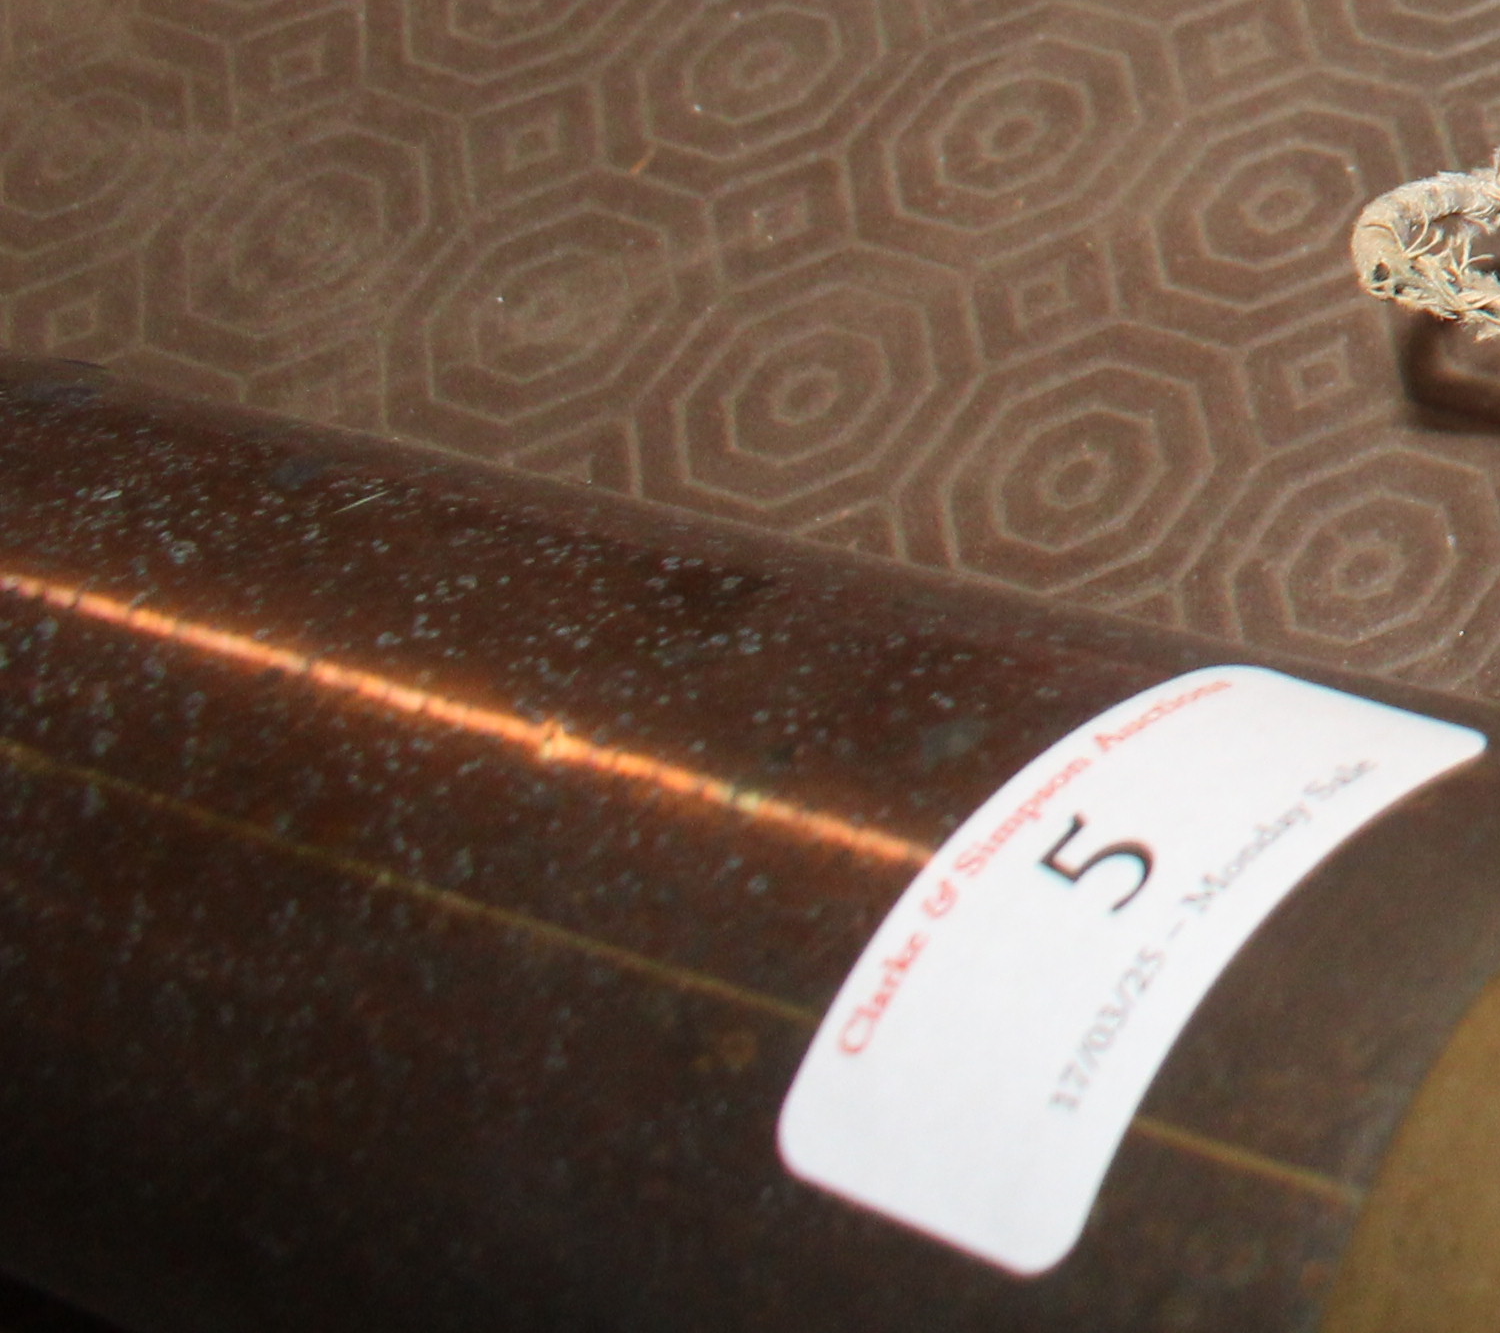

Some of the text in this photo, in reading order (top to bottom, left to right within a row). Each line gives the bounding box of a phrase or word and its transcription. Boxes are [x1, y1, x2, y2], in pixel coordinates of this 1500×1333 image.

[837, 679, 1233, 1056] Clarke & Simpson Auctions
[1038, 813, 1155, 914] 5
[1180, 803, 1312, 914] Monday
[1303, 758, 1378, 801] Sale
